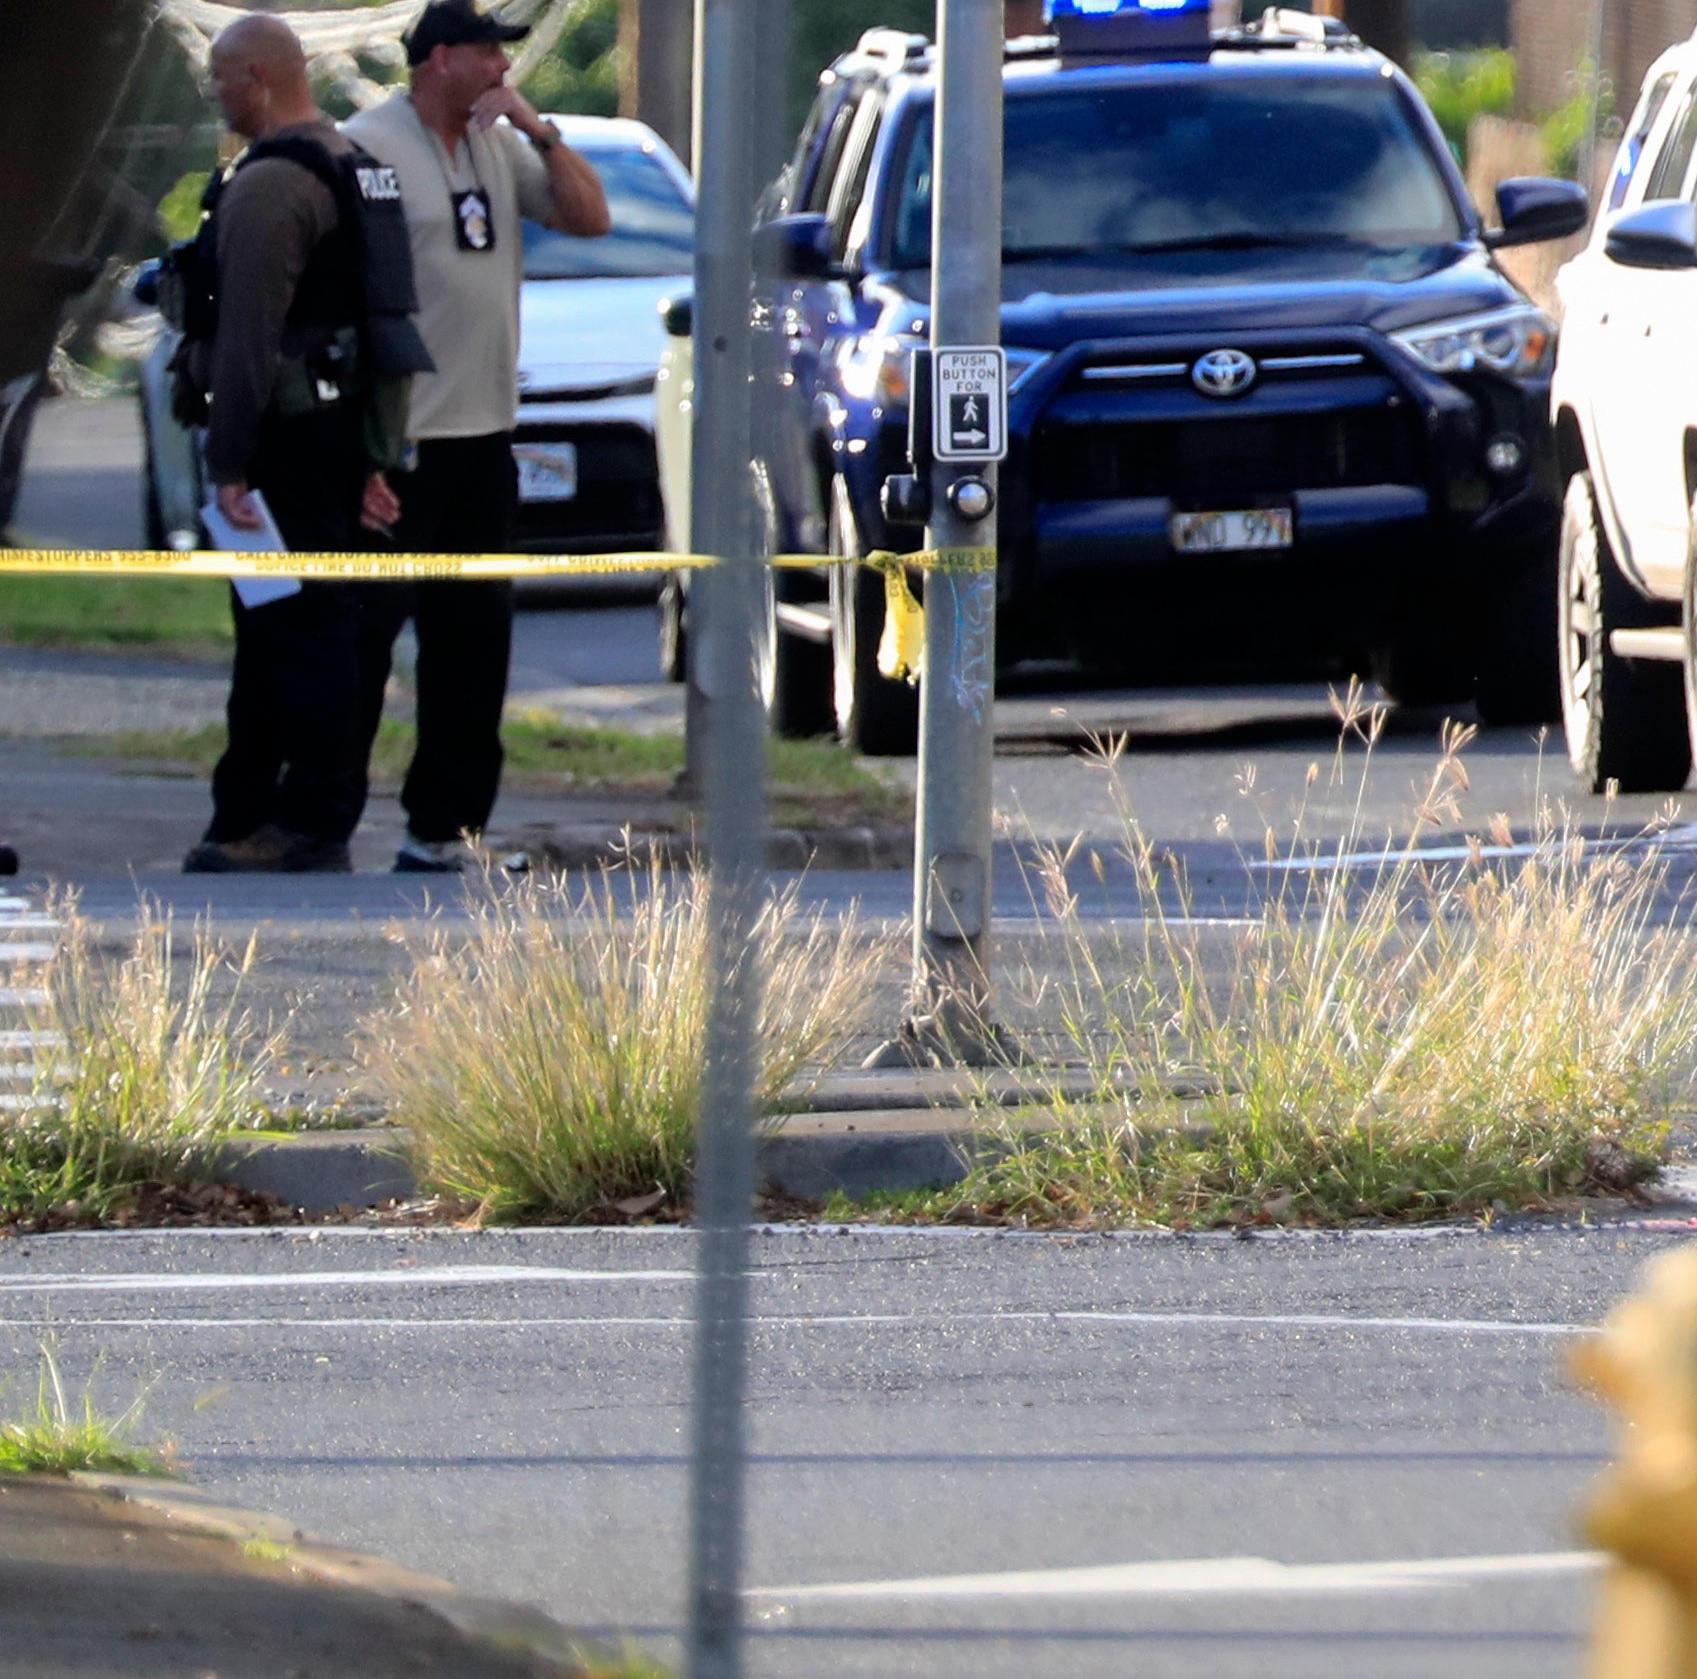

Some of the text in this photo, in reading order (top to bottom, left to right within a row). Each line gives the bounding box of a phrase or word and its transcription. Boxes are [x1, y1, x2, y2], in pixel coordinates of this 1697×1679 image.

[952, 355, 986, 366] PUSH
[943, 369, 996, 380] BUTTON
[956, 382, 982, 392] FOR
